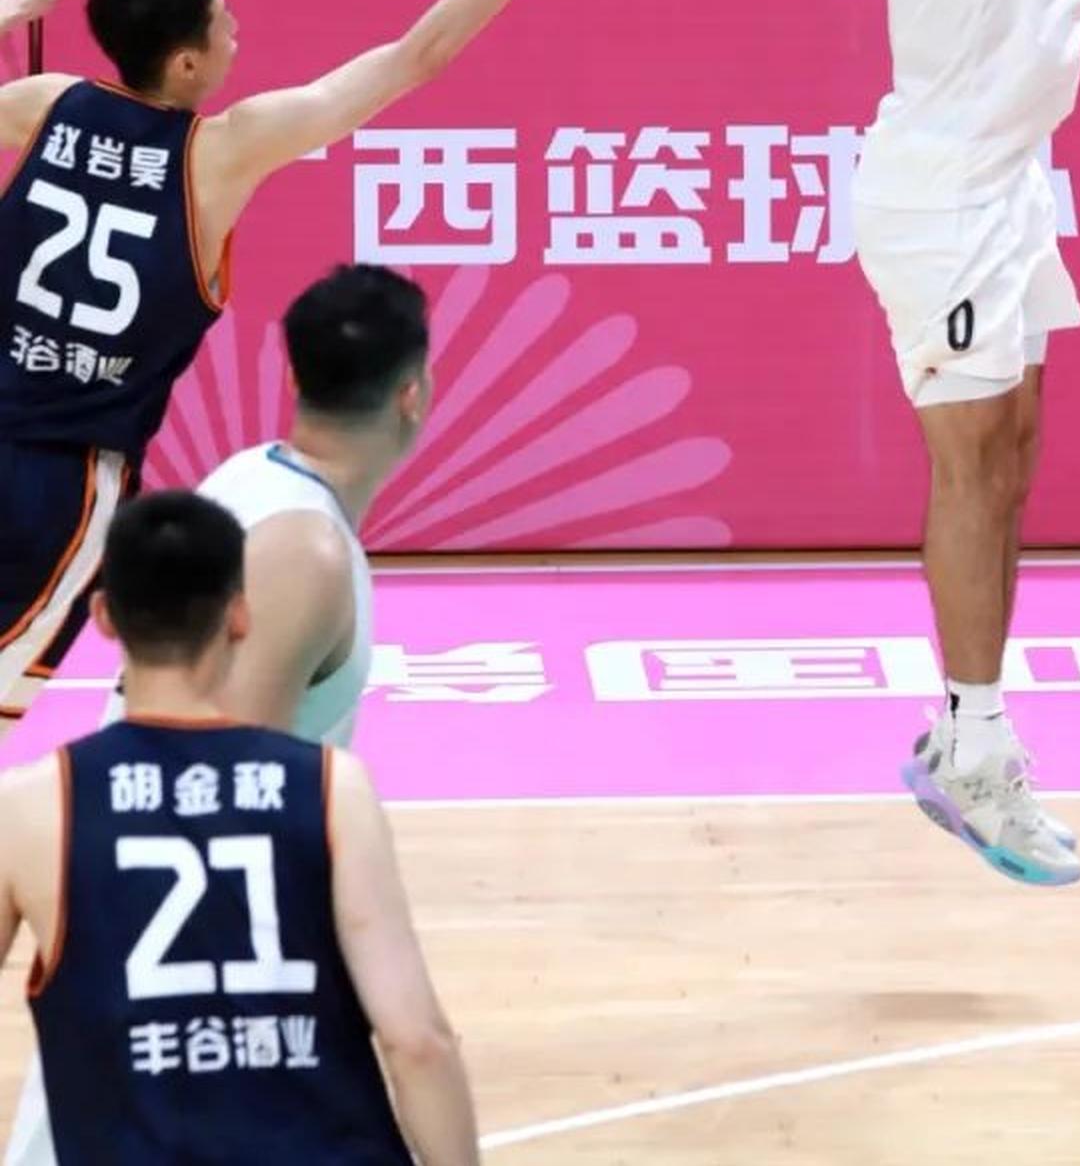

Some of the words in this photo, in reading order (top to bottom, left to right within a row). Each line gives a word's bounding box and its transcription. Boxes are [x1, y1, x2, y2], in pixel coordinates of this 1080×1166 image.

[41, 122, 170, 191] 赵岩昊
[16, 178, 157, 336] 25
[947, 298, 974, 352] 0
[109, 762, 286, 817] 胡金秋
[116, 834, 317, 1000] 21
[129, 1015, 319, 1075] 丰谷酒业
